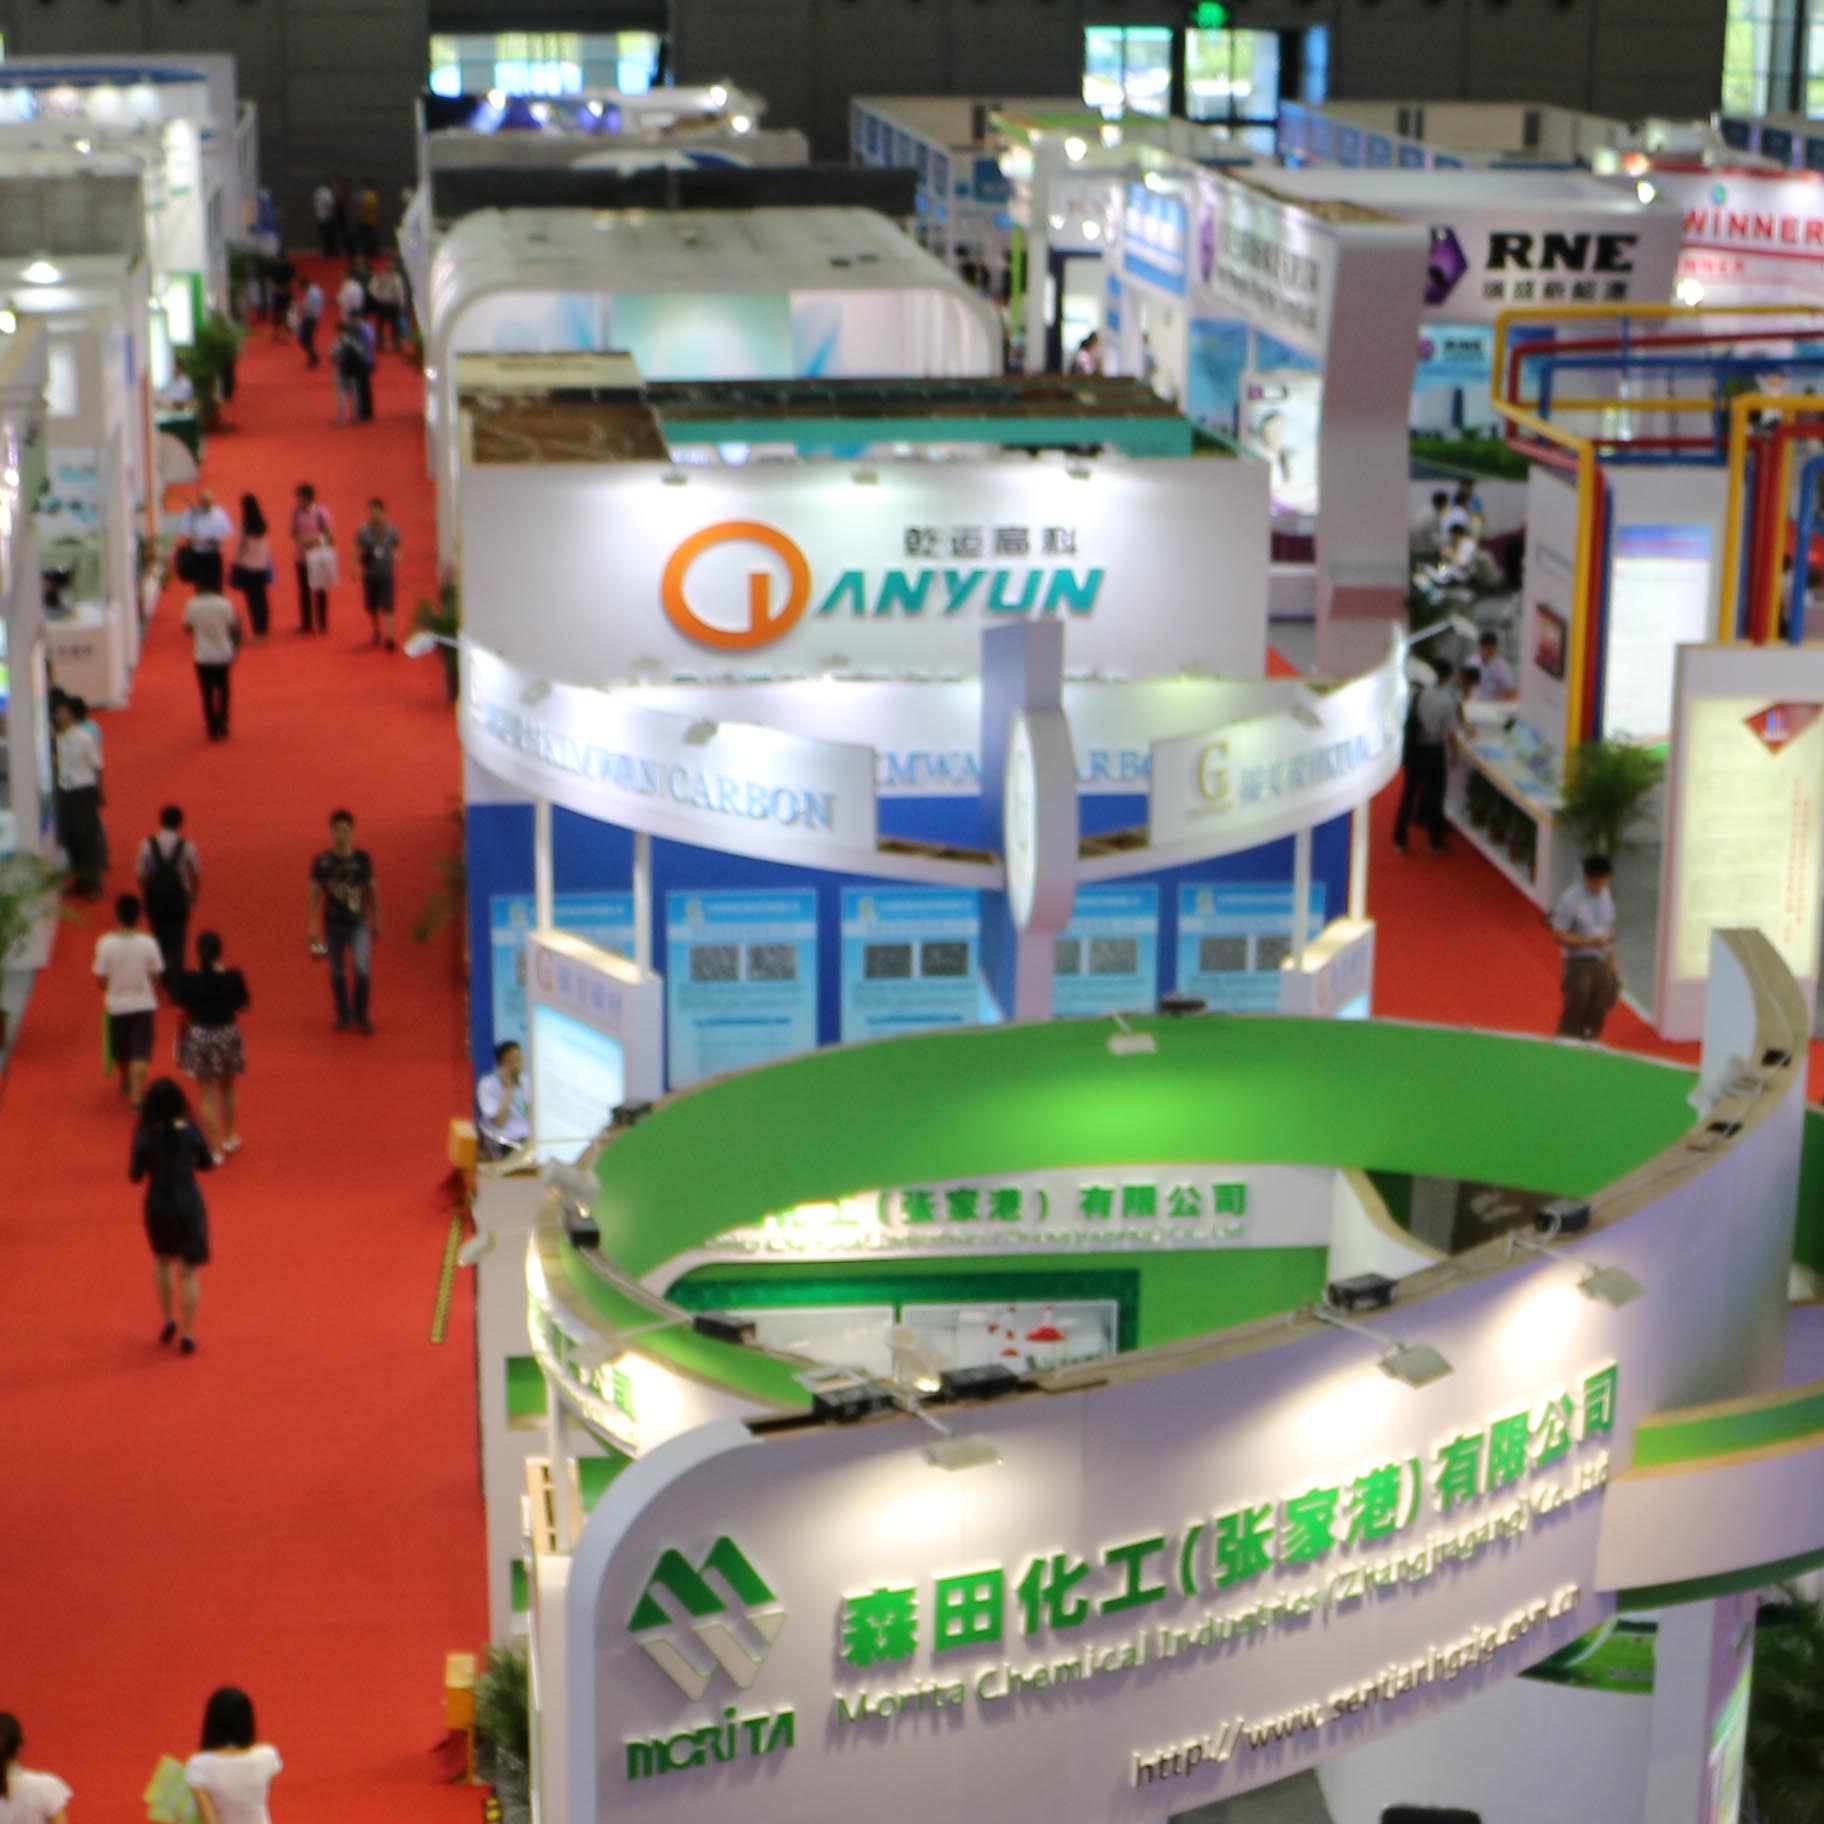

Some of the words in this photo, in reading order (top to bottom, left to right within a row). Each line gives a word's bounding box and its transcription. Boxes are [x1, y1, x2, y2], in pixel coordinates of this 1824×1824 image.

[1486, 231, 1638, 272] RNE
[669, 765, 838, 832] CARBON
[834, 1678, 966, 1727] Morita
[977, 1628, 1147, 1703] Chemical
